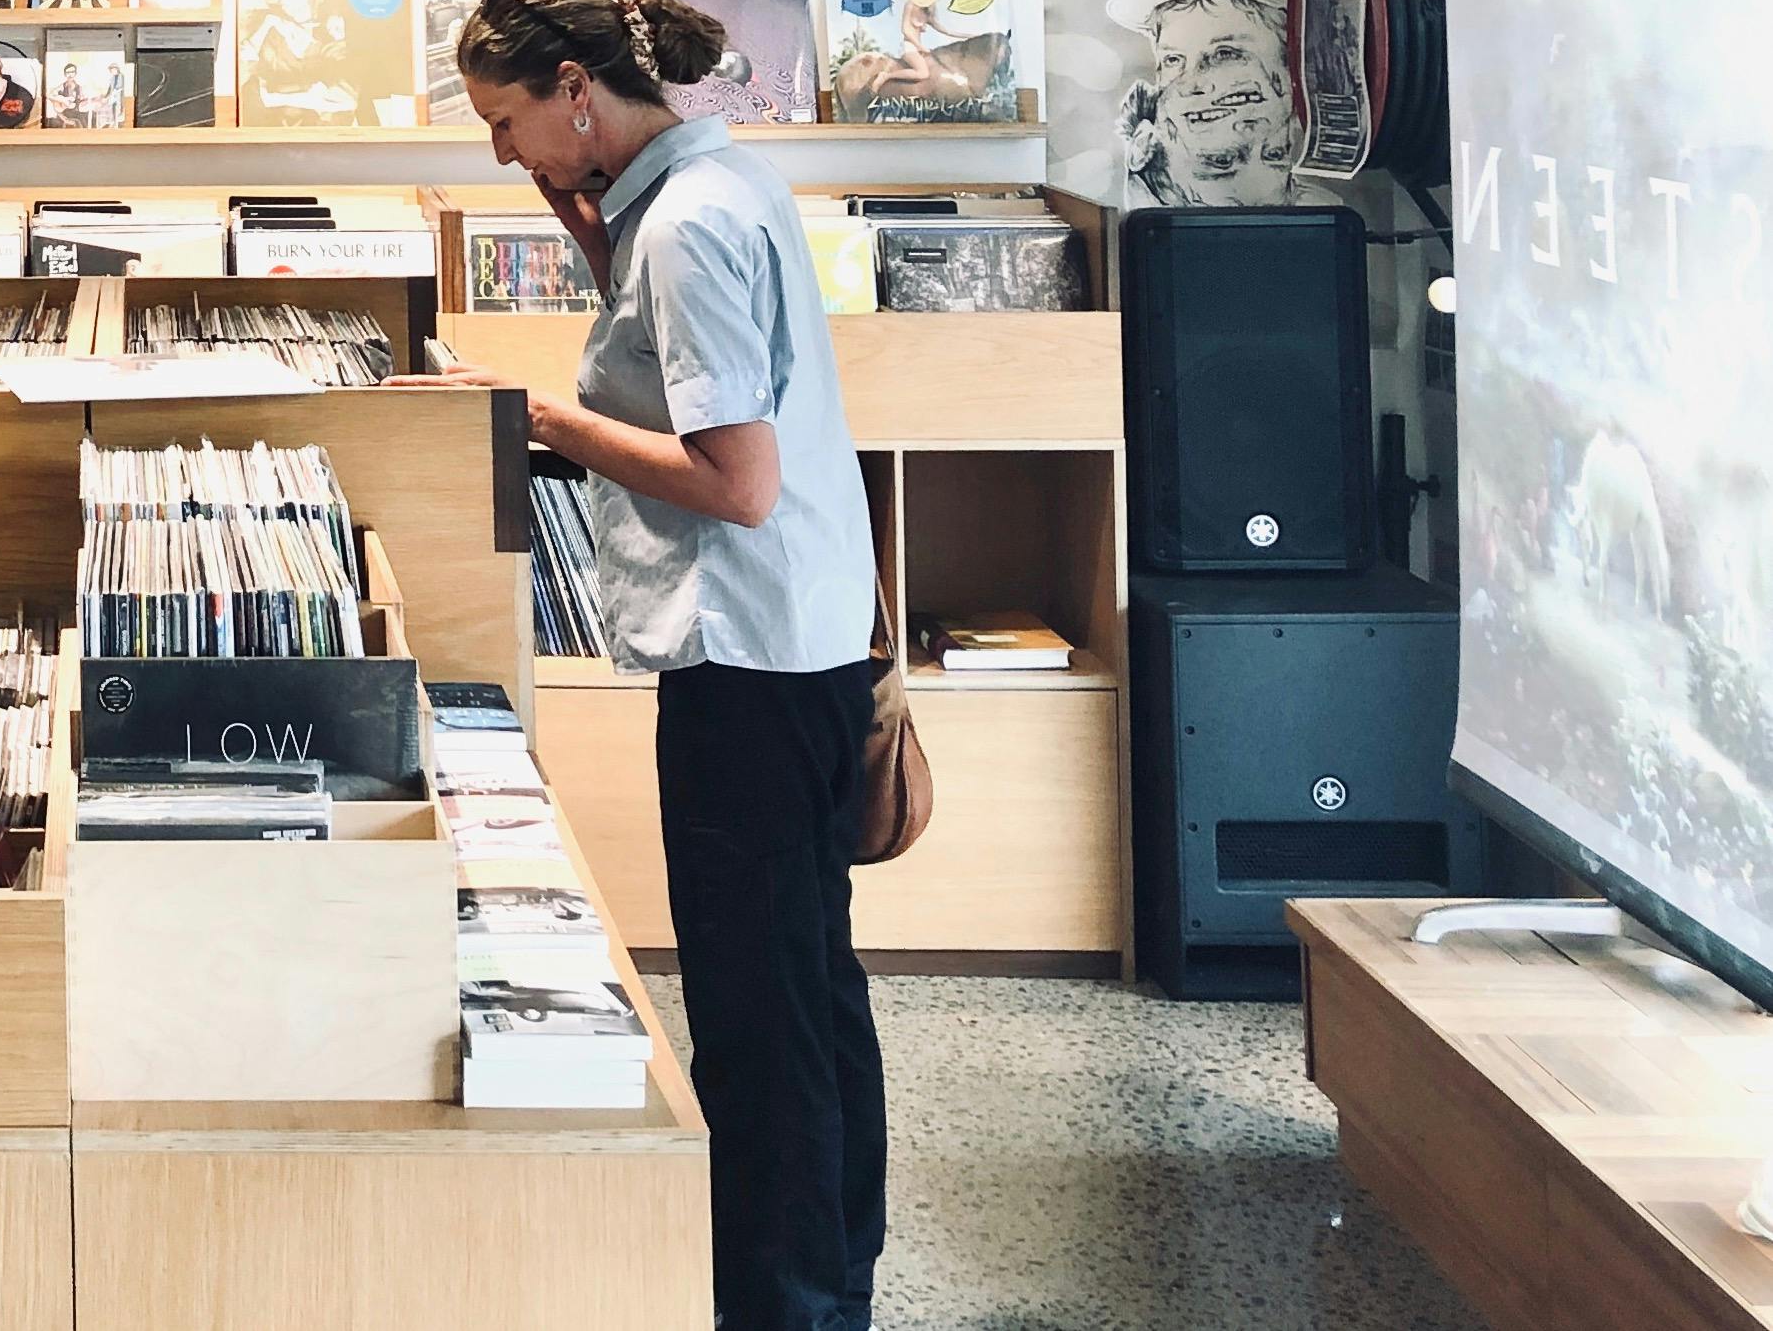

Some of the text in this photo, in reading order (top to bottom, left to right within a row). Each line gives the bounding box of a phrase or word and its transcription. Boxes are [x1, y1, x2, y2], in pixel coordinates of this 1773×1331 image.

[268, 243, 404, 259] BURN YOUR FIRE
[186, 721, 314, 766] LOW
